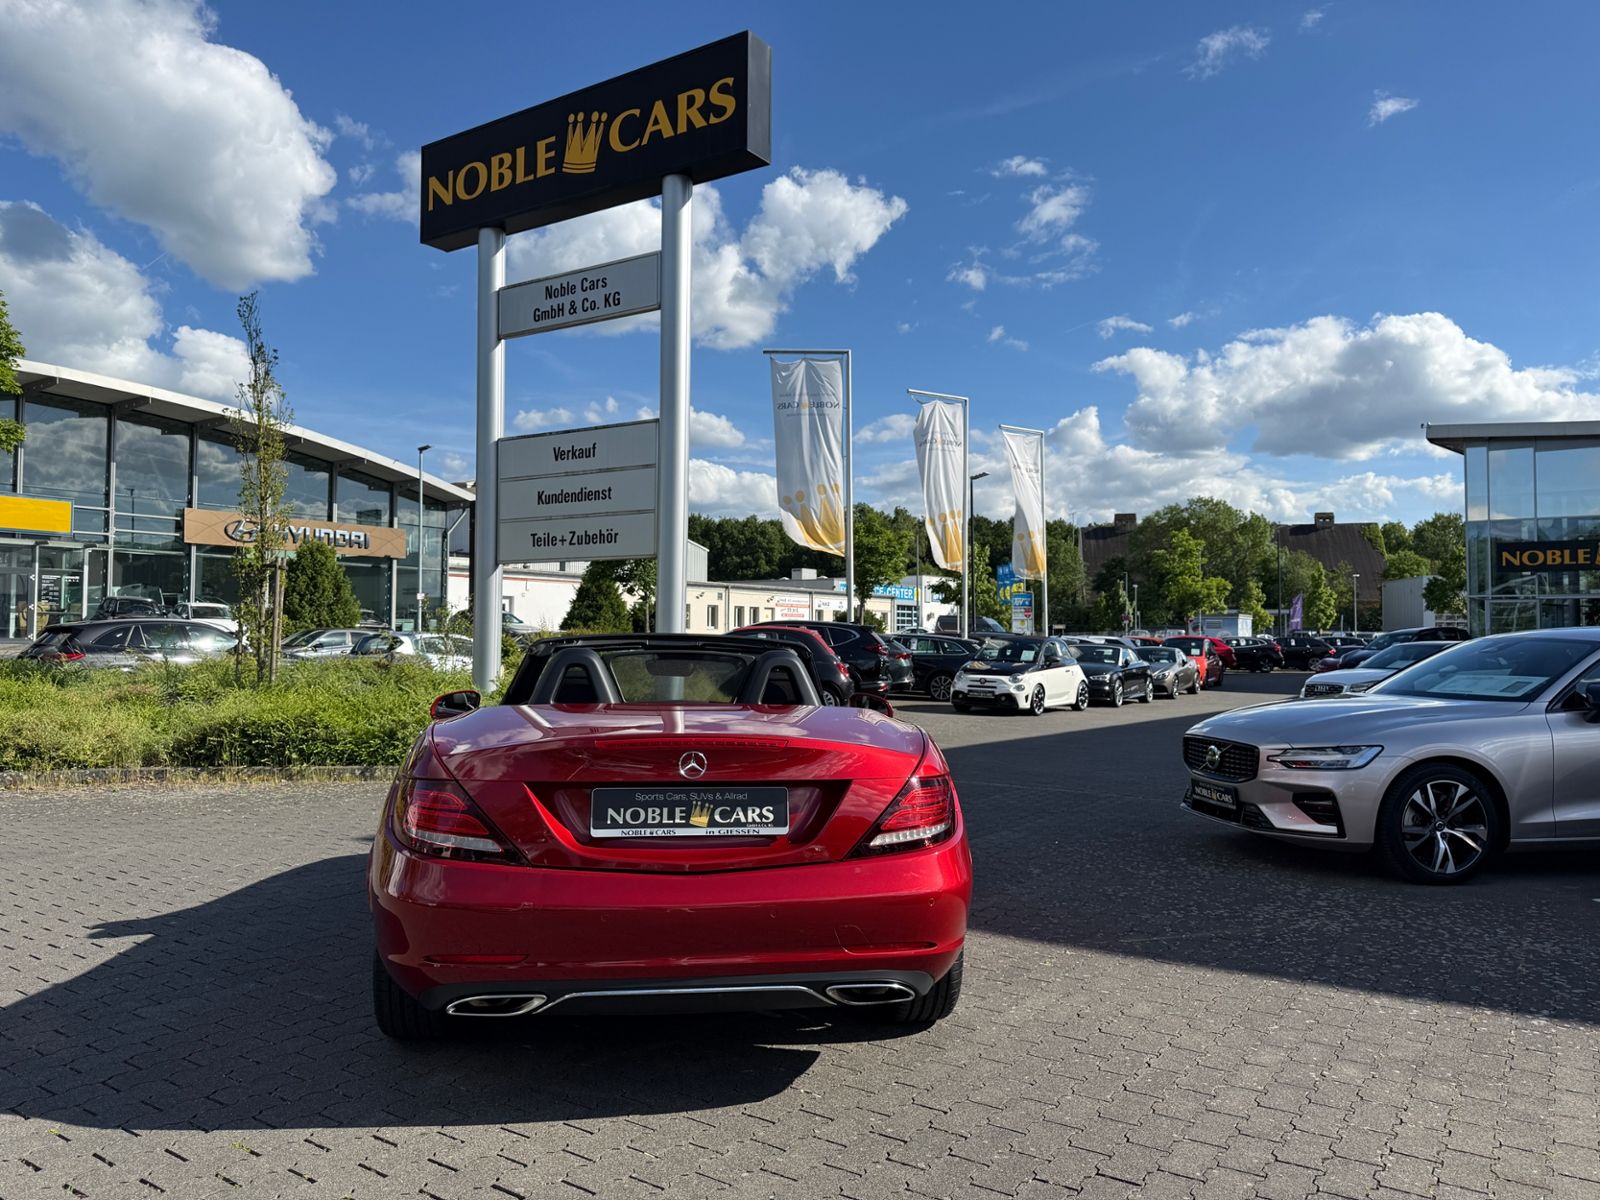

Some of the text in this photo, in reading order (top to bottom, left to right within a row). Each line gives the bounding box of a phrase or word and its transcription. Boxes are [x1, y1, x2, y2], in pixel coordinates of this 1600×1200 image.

[428, 76, 736, 212] NOBLE CARS
[545, 277, 608, 301] Noble Cars
[533, 291, 621, 323] GmbH & Co. KG
[553, 442, 597, 462] Verkauf
[537, 486, 612, 506] Kundendienst
[530, 528, 619, 548] Teile+Zubehör
[1502, 548, 1591, 567] NOBLE
[635, 792, 748, 802] Sports Cars, SUVs & Allrad
[607, 806, 775, 825] NOBLE CARS
